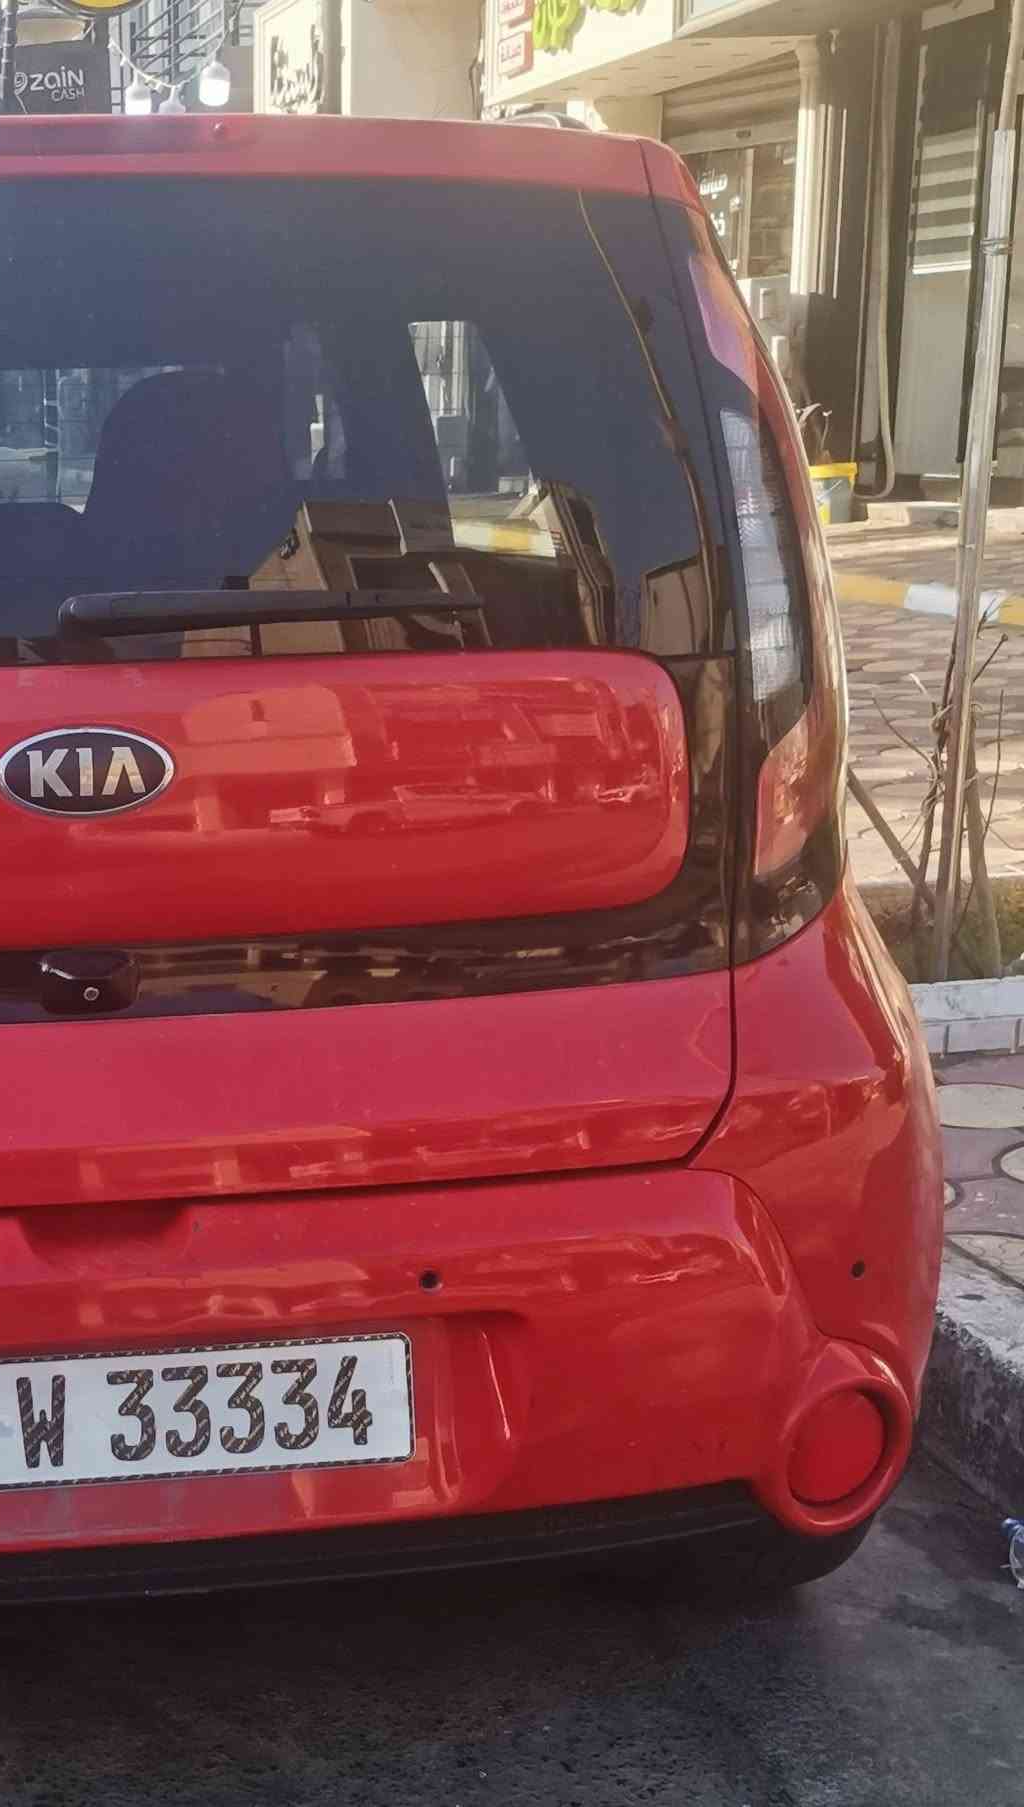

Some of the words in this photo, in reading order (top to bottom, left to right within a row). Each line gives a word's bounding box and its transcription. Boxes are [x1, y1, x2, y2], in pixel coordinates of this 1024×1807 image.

[51, 87, 85, 102] CASH
[27, 746, 146, 798] KIA
[16, 1374, 66, 1469] W
[106, 1355, 374, 1462] 33334
